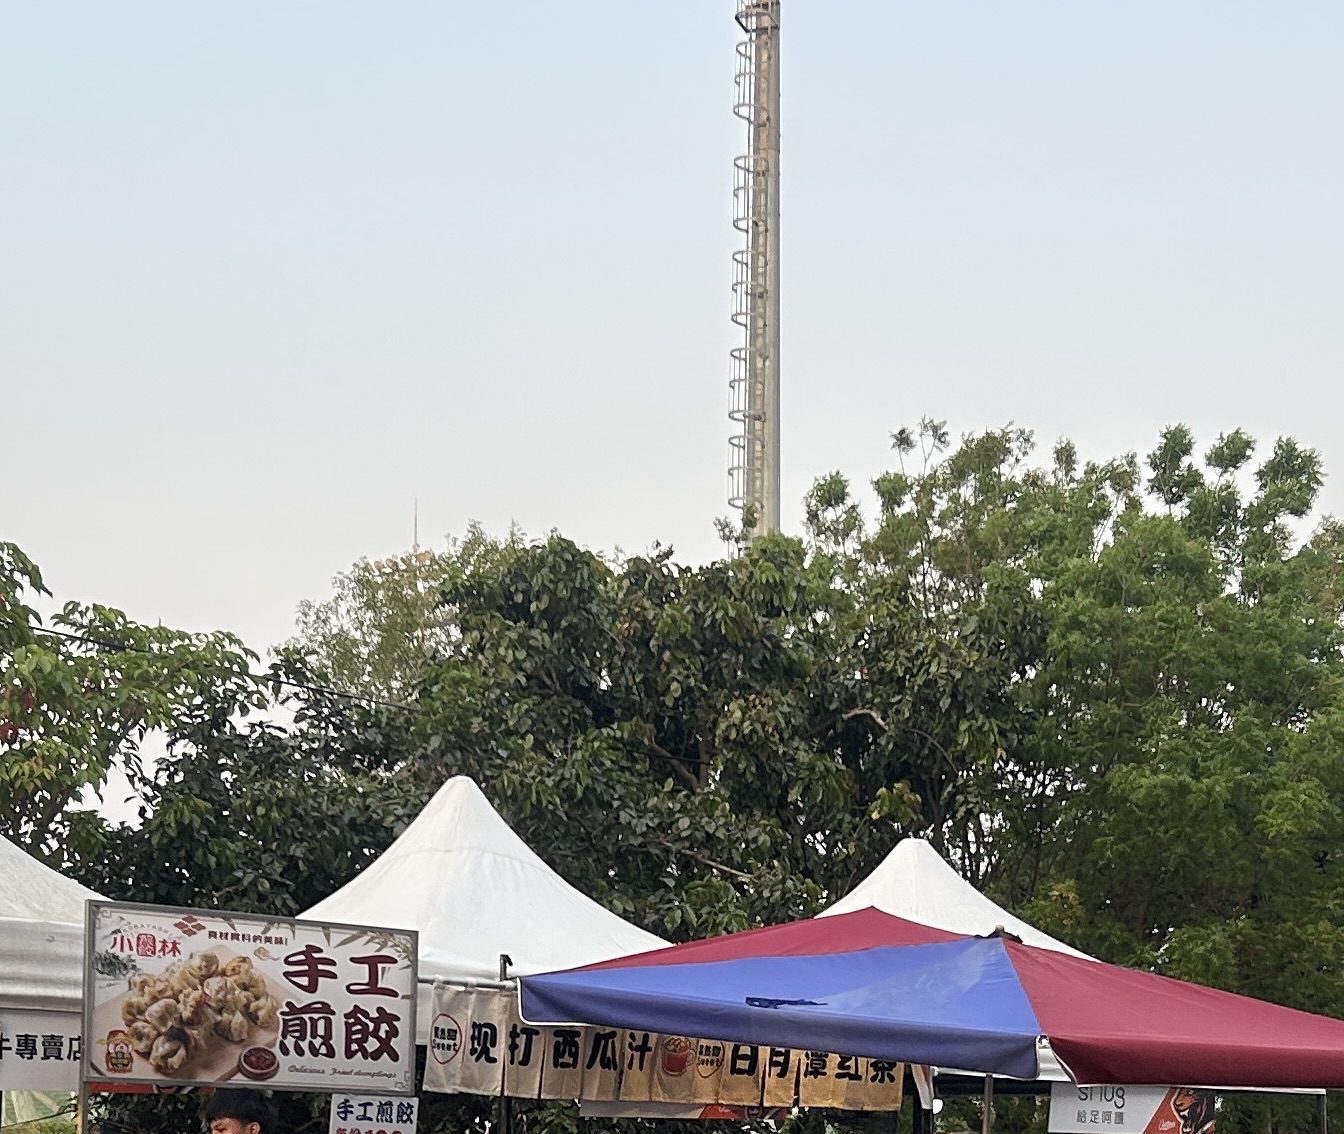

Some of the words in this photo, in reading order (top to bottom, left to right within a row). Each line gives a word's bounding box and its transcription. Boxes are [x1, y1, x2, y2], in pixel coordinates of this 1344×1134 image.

[282, 944, 401, 998] 手工
[279, 1001, 402, 1062] 煎餃
[336, 1098, 414, 1125] 手工煎餃
